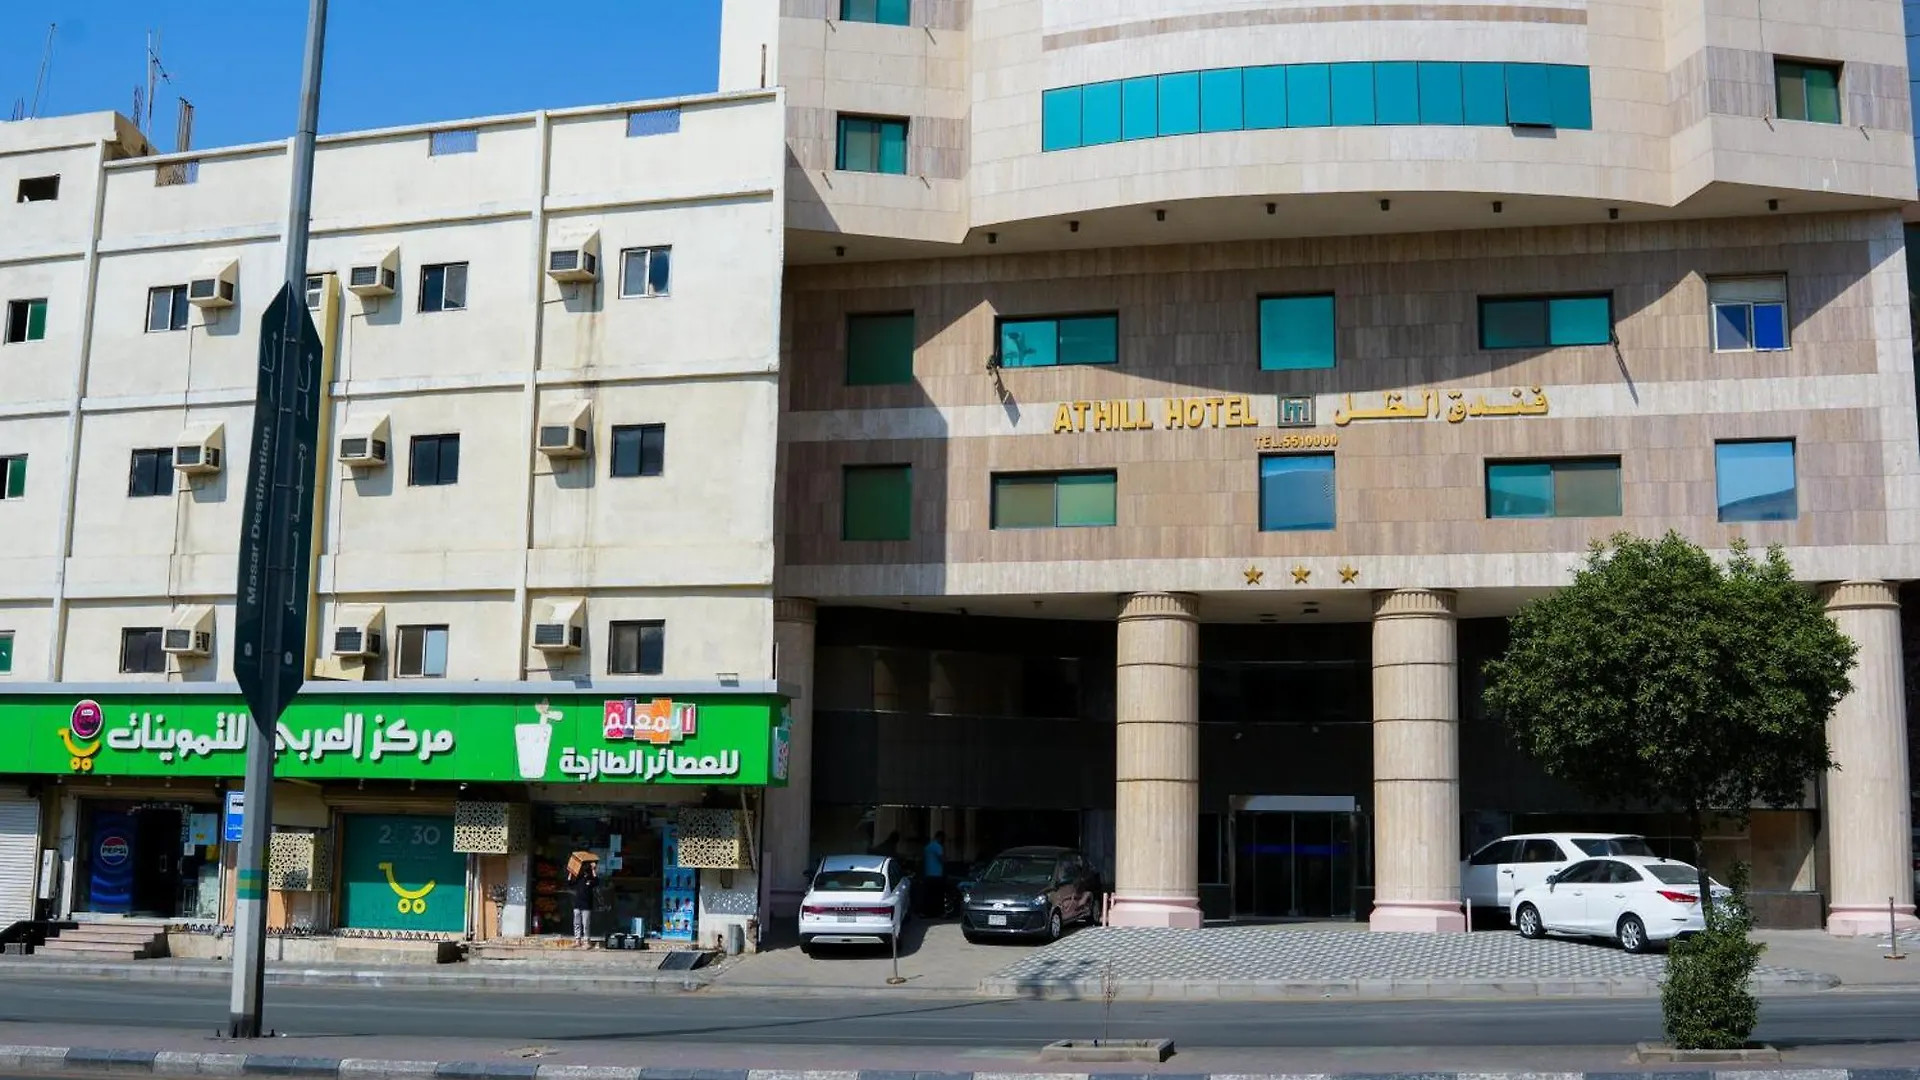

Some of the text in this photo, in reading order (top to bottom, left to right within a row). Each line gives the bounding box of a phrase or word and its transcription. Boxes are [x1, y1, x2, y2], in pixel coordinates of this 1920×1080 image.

[1054, 394, 1259, 434] ATHILL HOTEL
[1447, 384, 1549, 424] فندق
[246, 426, 270, 605] Masar Destination
[285, 443, 307, 615] وجهة مسار
[106, 711, 247, 761] للتموينات
[370, 714, 453, 761] مركز
[604, 703, 694, 738] المعلم
[559, 747, 644, 782] الطازجة
[644, 747, 739, 781] للعصائر
[102, 845, 128, 856] PEPSI
